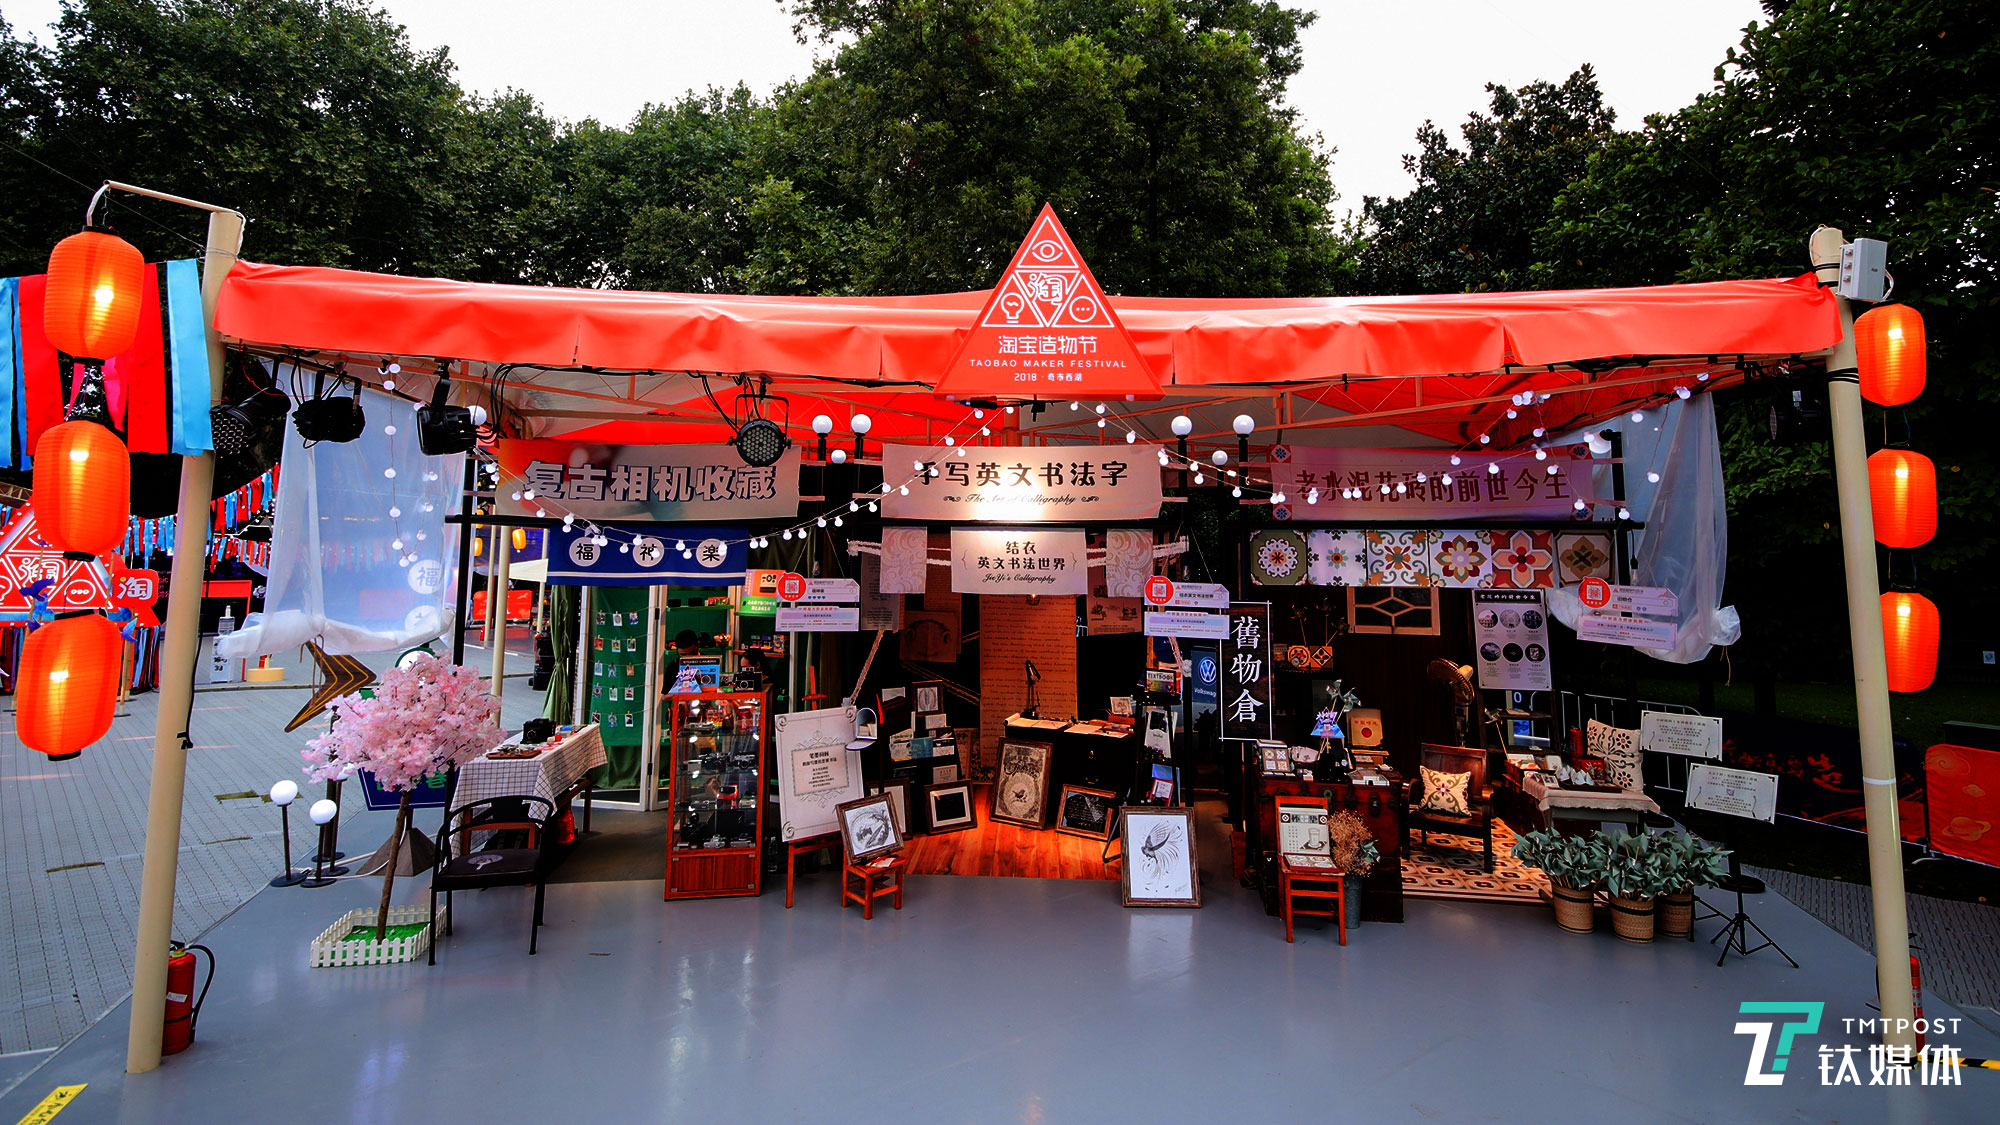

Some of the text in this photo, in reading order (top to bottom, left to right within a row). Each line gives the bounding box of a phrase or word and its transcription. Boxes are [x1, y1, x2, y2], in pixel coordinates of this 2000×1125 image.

[998, 336, 1097, 354] 淘宝造物节
[969, 359, 1127, 368] TAOBAO MAKER FESTIVAL
[1014, 373, 1037, 382] 2018
[523, 460, 778, 502] 复古相机收藏
[914, 460, 1128, 487] 手写英文书法字
[1295, 467, 1571, 503] 老水泥花砖的前世今生
[965, 493, 986, 503] The
[1020, 493, 1077, 505] Calligraphy
[1005, 540, 1037, 555] 结衣
[977, 556, 1066, 571] 英文书法世界
[1014, 573, 1056, 584] Calligraphy
[117, 577, 153, 601] 淘
[1228, 616, 1264, 723] 舊物倉
